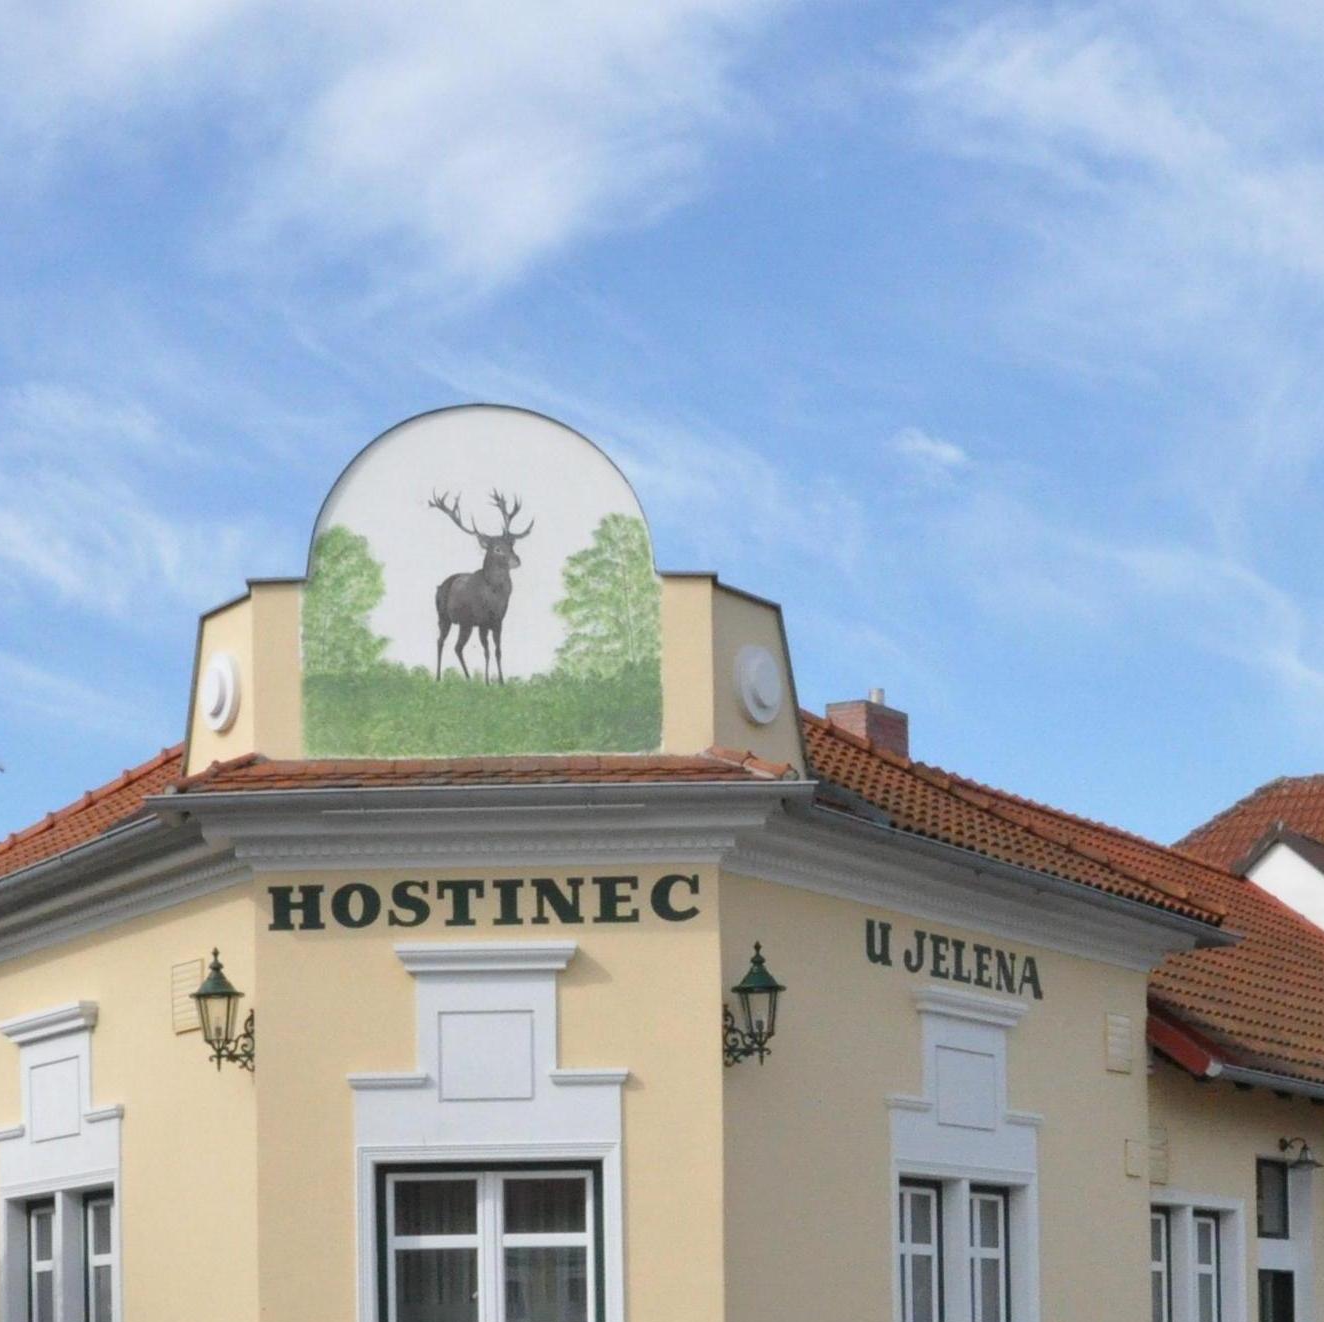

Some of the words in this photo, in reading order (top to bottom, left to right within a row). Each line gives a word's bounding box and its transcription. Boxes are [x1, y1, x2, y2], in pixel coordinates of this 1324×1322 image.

[267, 874, 700, 931] HOSTINEC
[865, 918, 893, 966] U
[903, 930, 1043, 1000] JELENA
